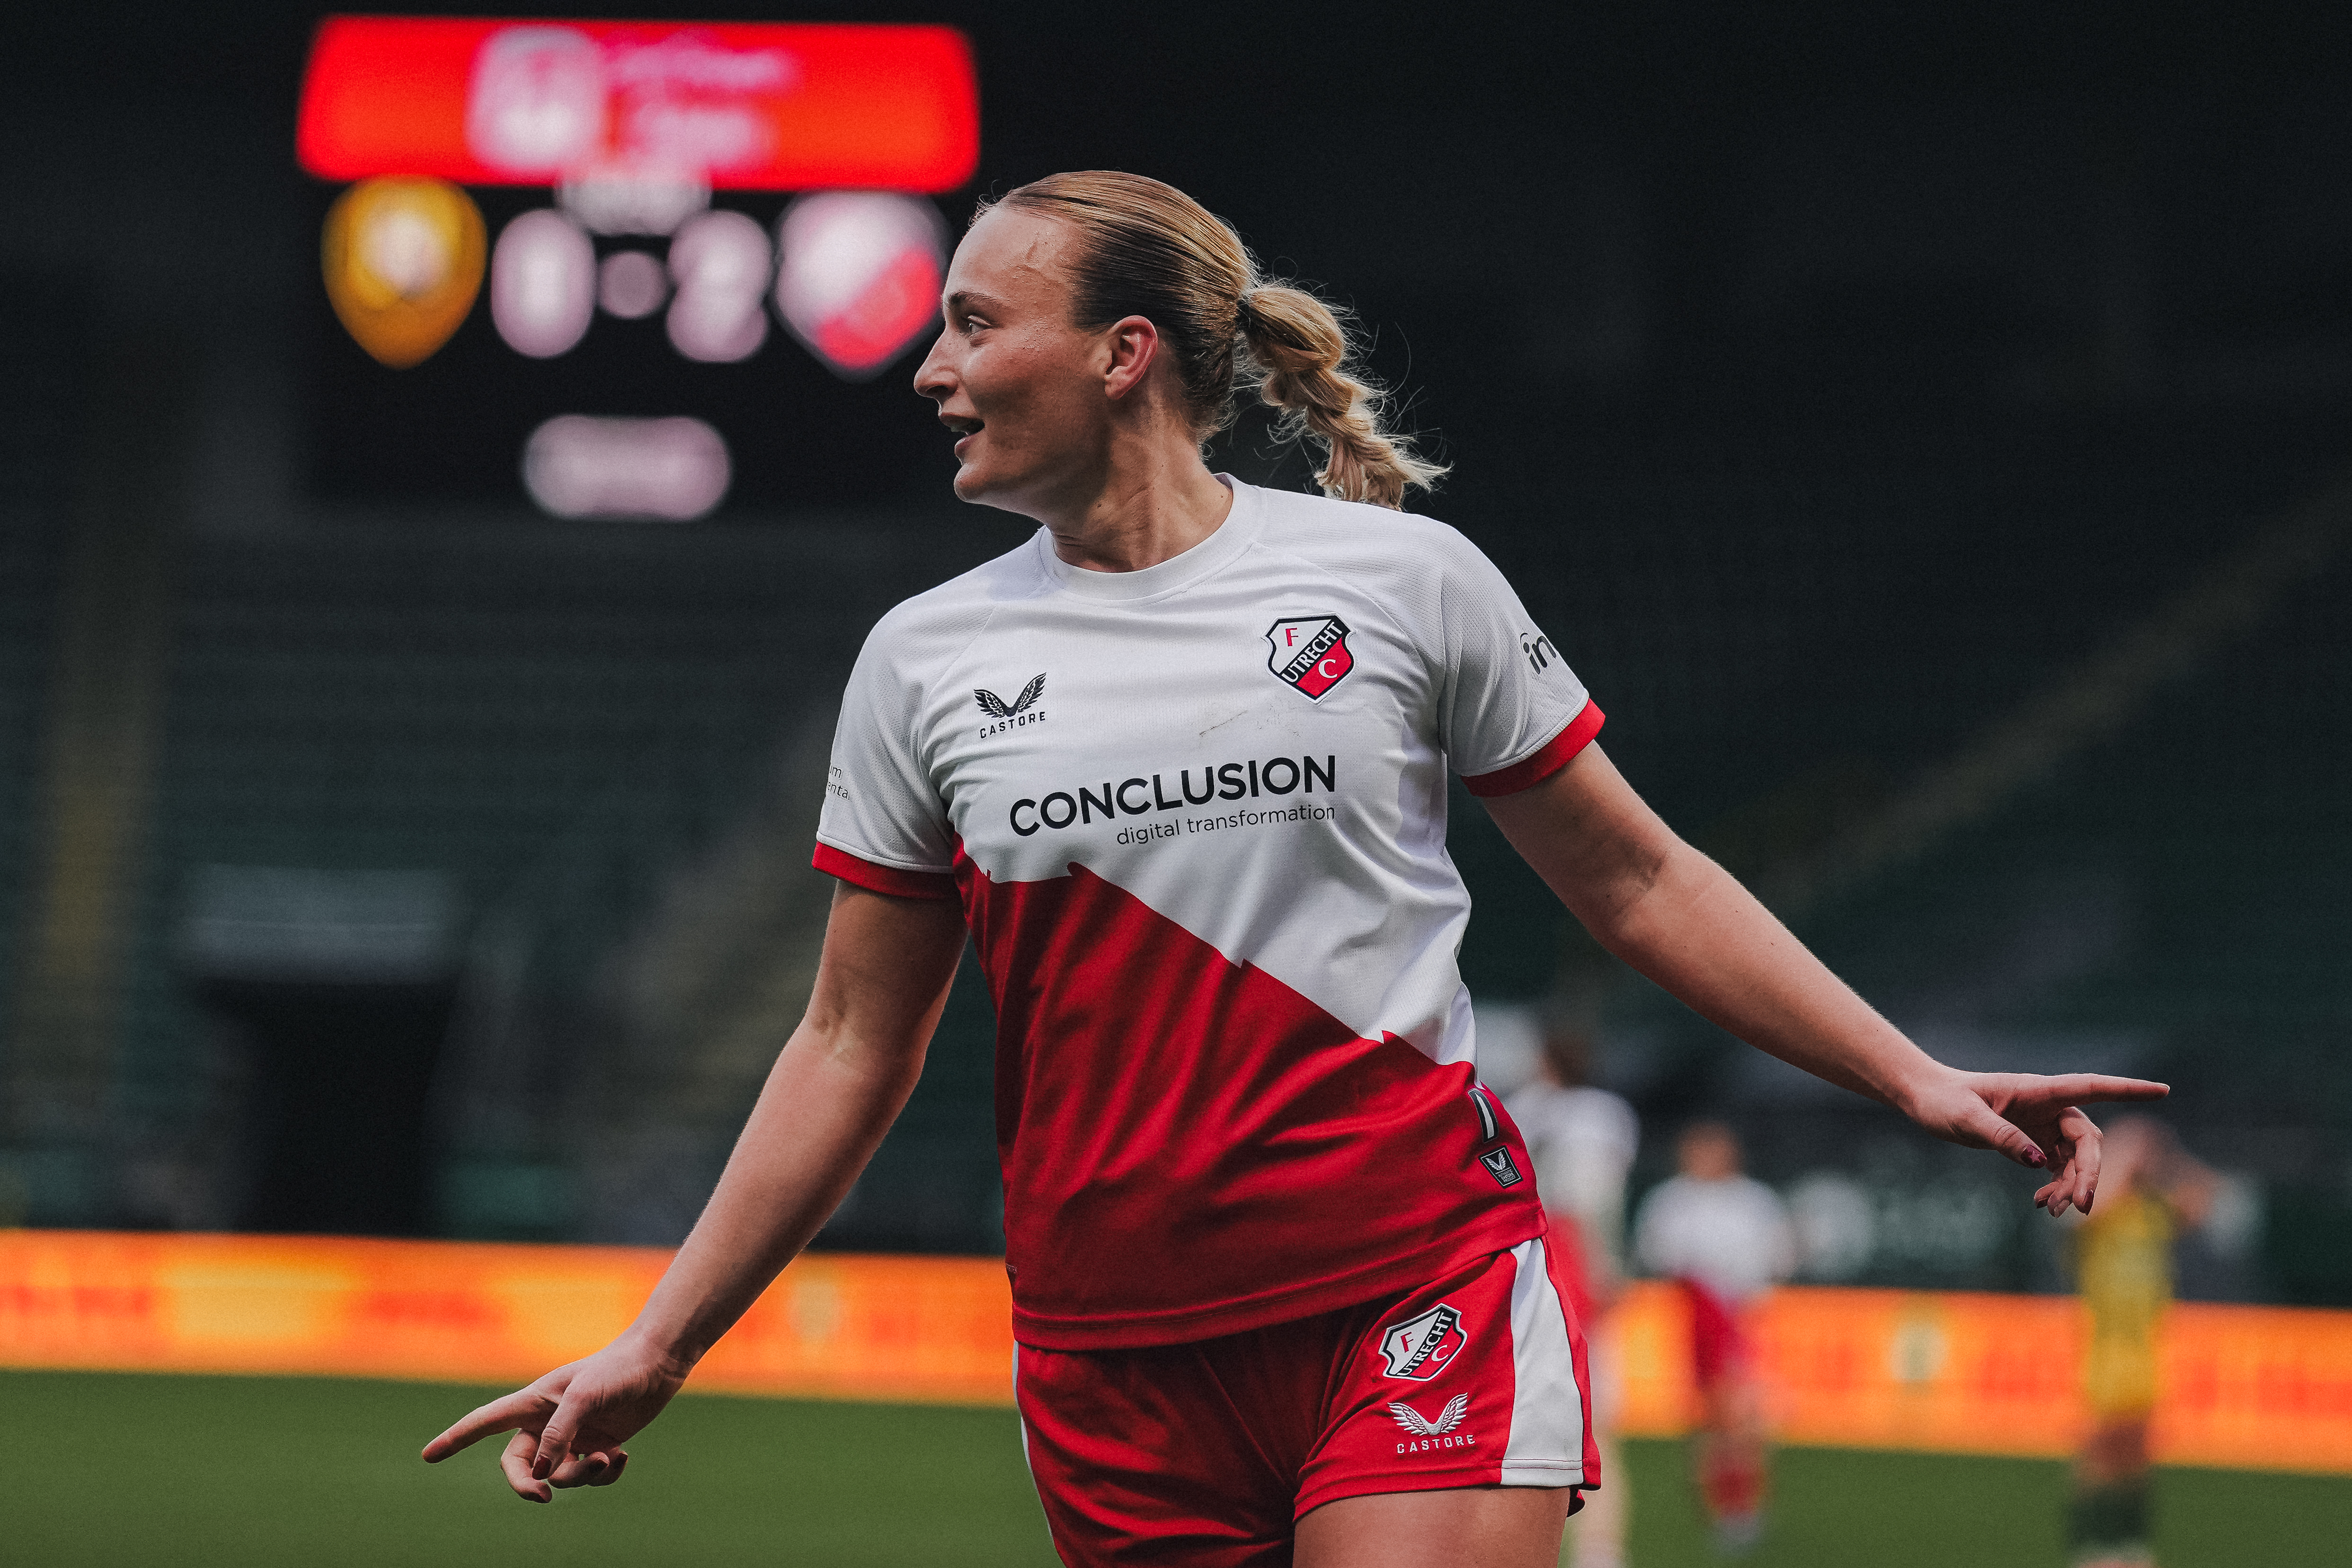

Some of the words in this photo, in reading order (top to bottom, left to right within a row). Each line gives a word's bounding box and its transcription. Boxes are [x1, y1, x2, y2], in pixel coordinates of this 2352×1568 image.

[1286, 628, 1298, 647] F
[1281, 621, 1342, 682] UTRECHT
[1318, 658, 1338, 679] C
[980, 711, 1046, 739] CASTORE
[1010, 755, 1335, 836] CONCLUSION
[1117, 819, 1180, 845] digital
[1187, 805, 1335, 833] transformation
[1396, 1312, 1453, 1376] UTRECHT
[1400, 1331, 1414, 1353] F
[1431, 1344, 1449, 1362] C
[1396, 1435, 1476, 1454] CASTORE
